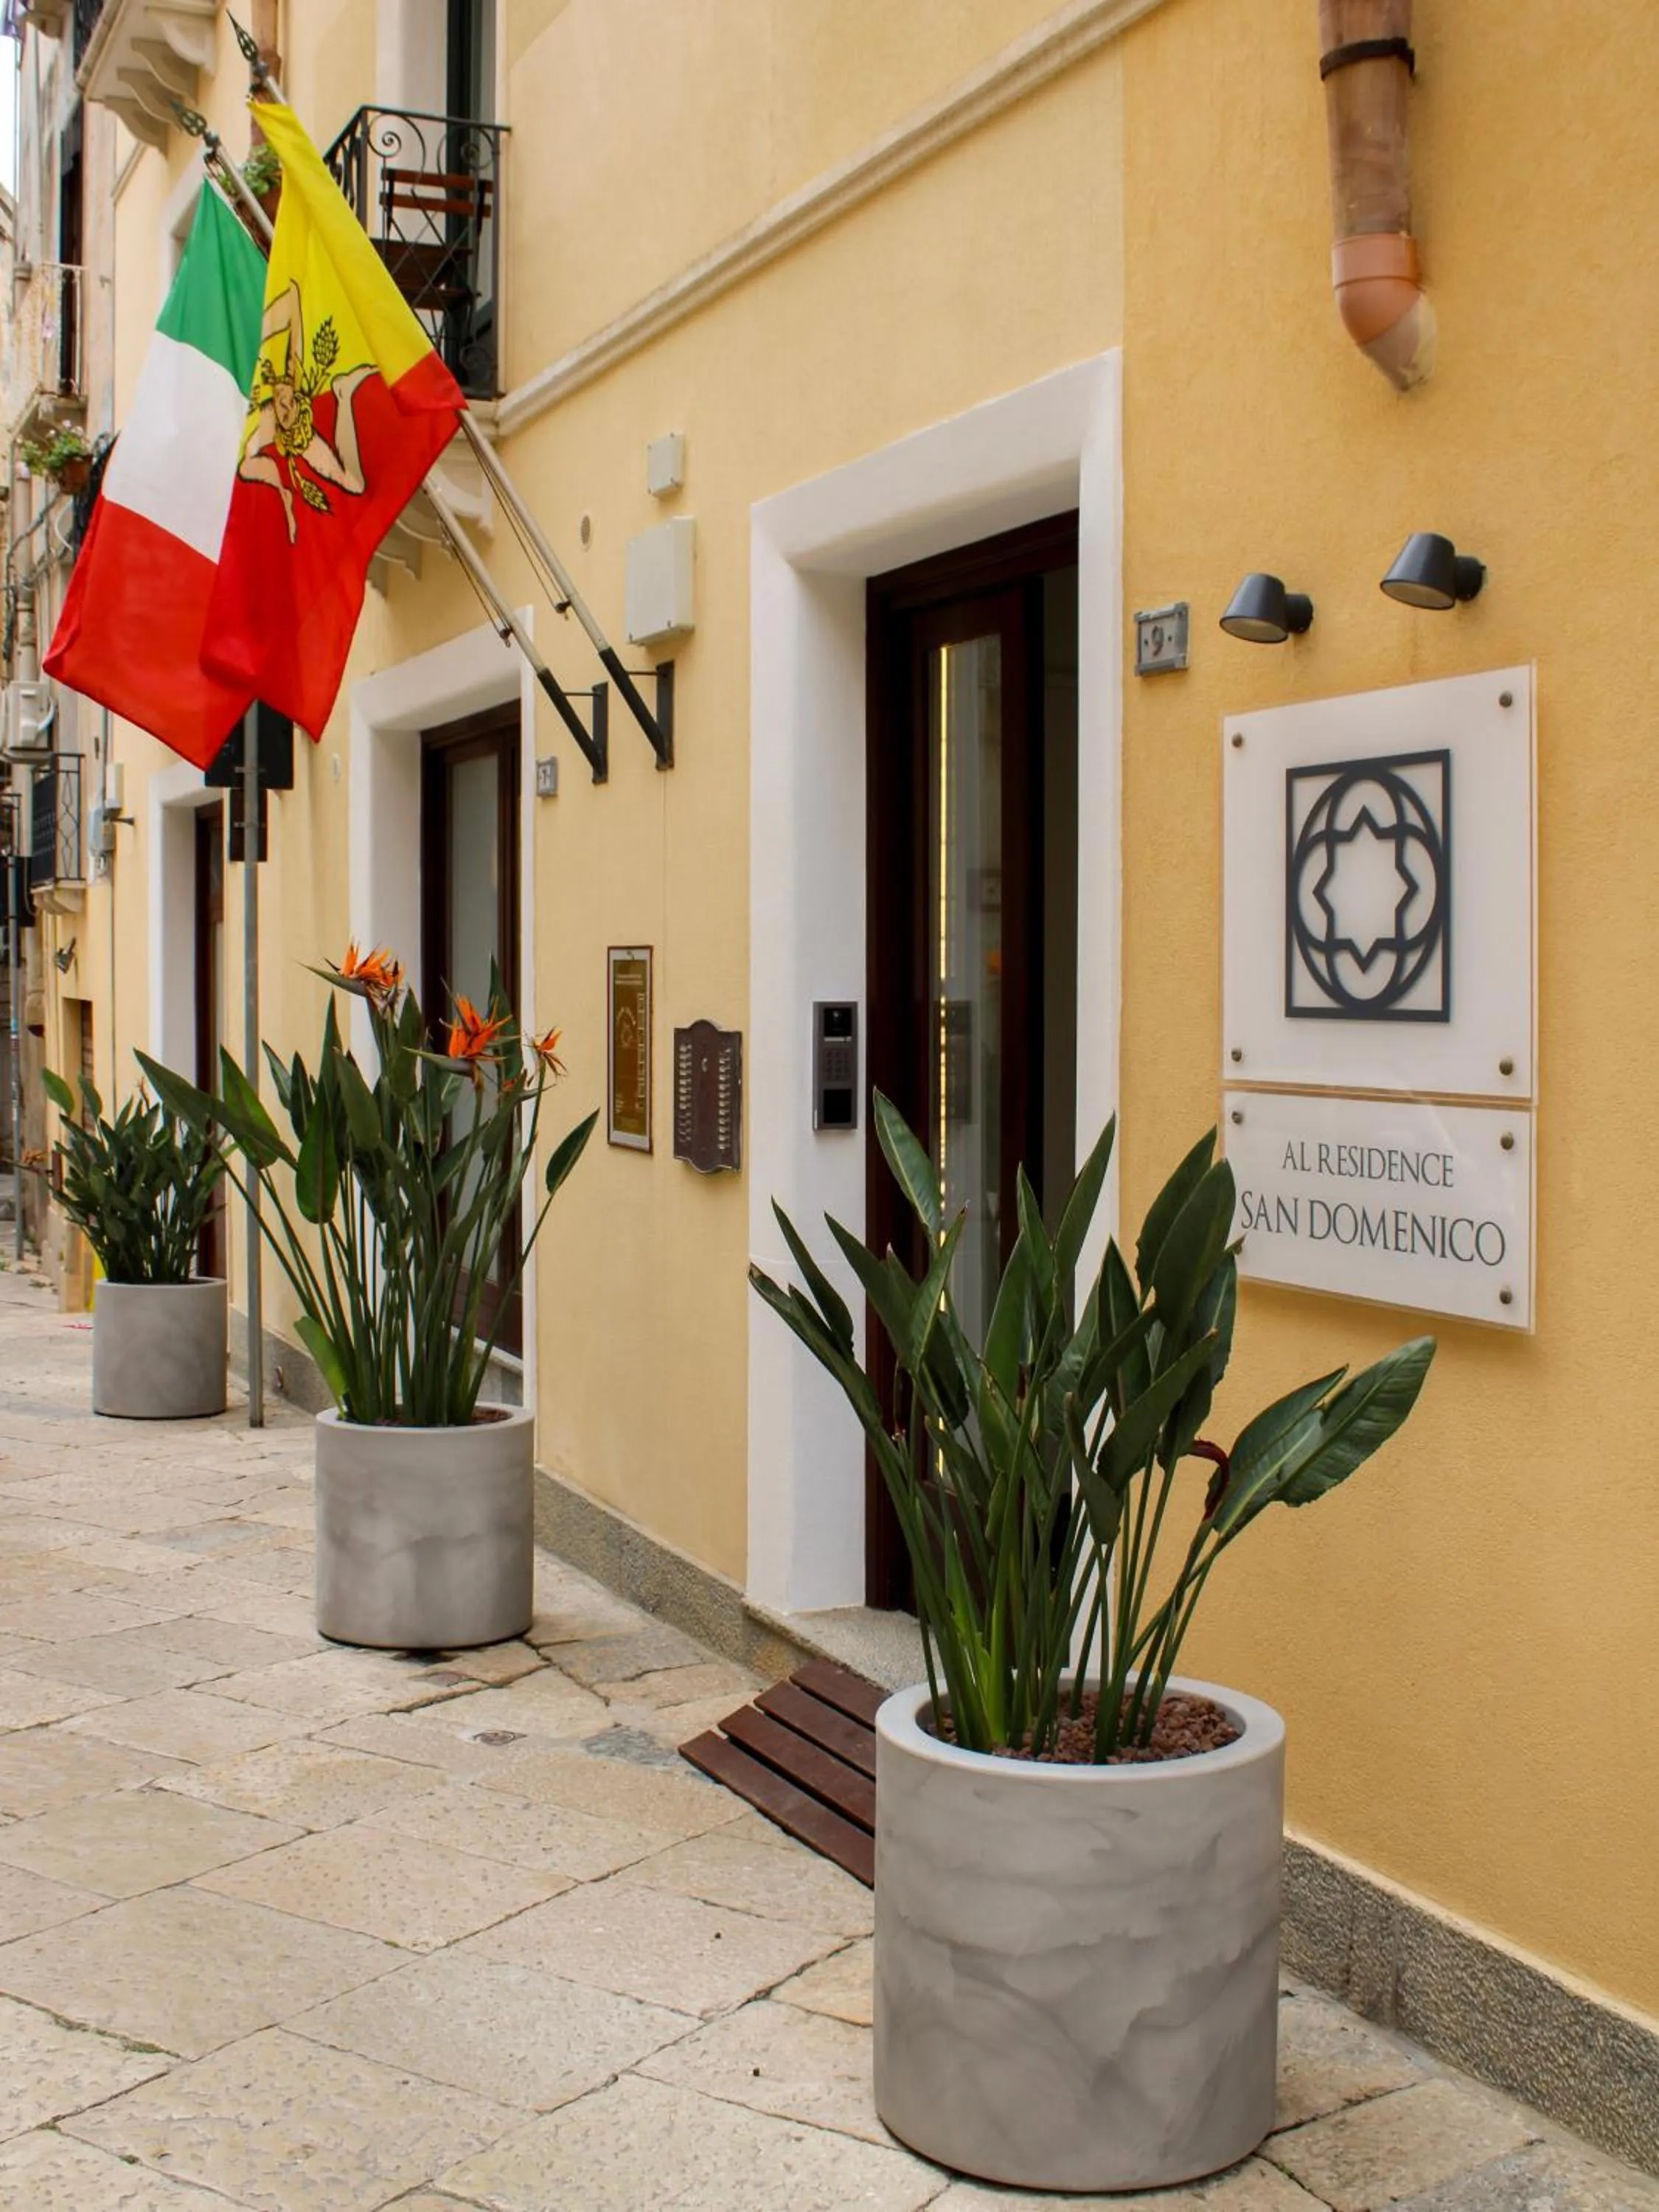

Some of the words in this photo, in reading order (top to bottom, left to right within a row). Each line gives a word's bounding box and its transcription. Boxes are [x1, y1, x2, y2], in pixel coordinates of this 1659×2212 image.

[1151, 625, 1164, 657] 9
[1281, 1141, 1311, 1172] AL
[1318, 1144, 1454, 1187] RESIDENCE
[1241, 1191, 1298, 1236] SAN
[1308, 1199, 1505, 1266] DOMENICO
